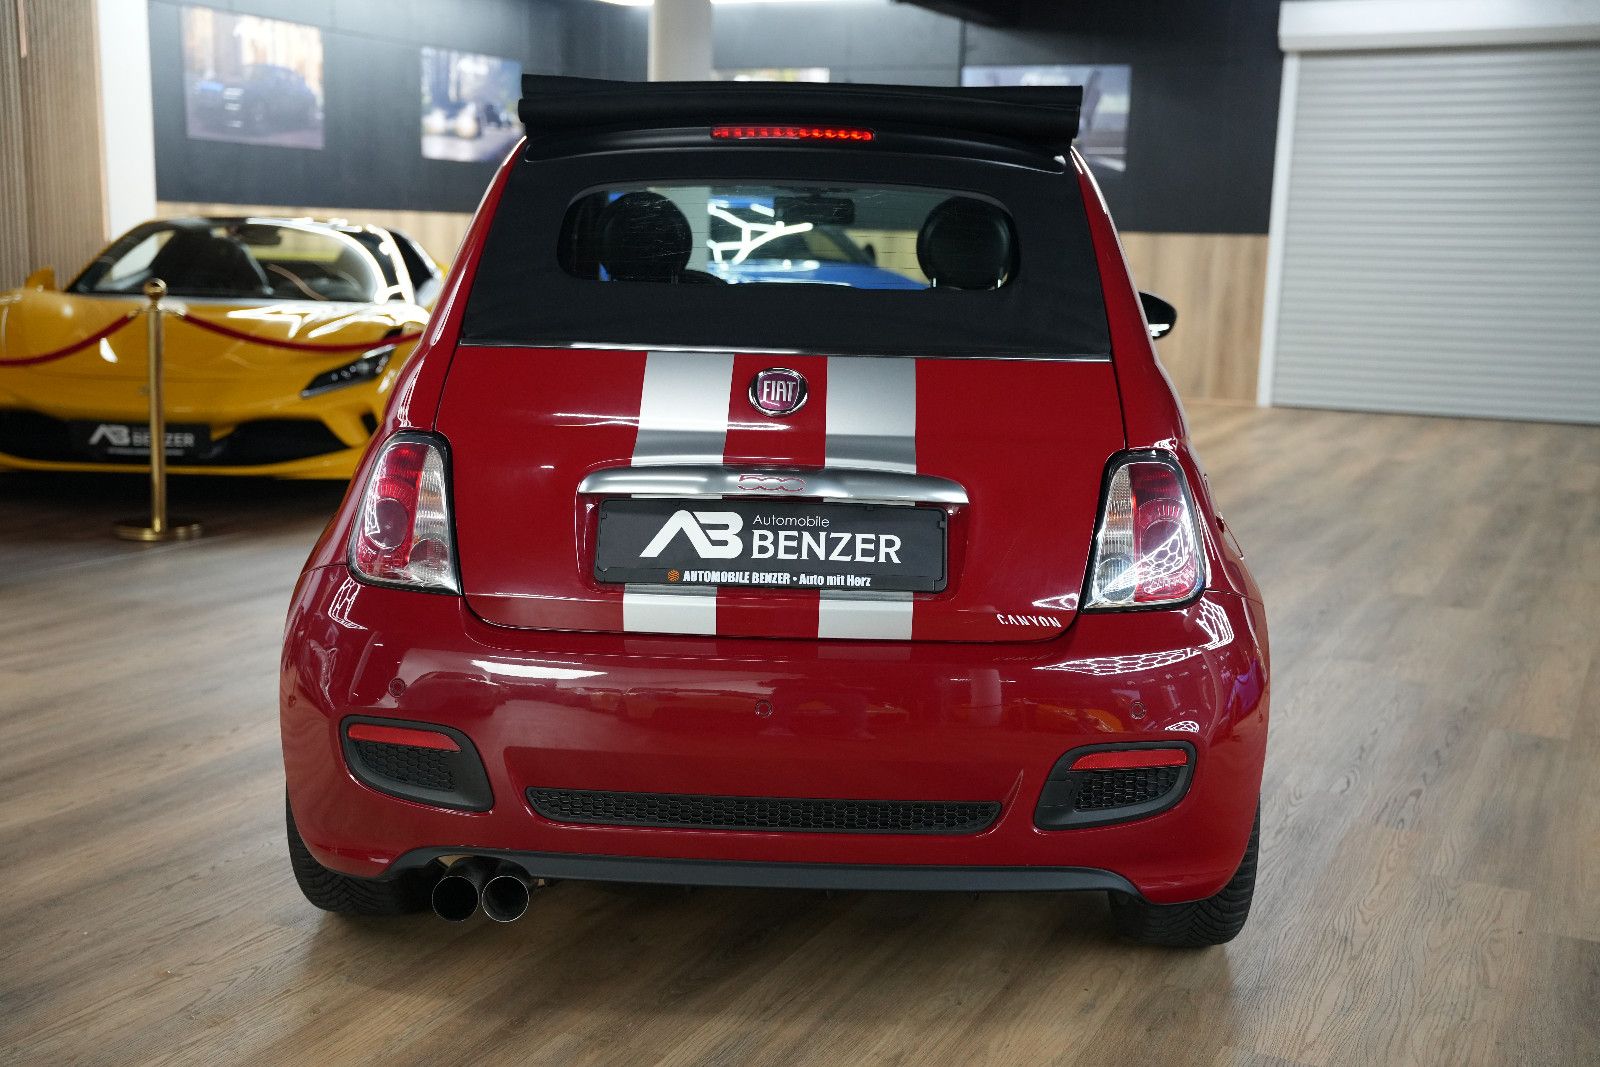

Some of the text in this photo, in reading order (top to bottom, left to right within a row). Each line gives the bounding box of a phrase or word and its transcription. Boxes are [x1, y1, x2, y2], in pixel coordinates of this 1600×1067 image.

[762, 380, 797, 402] FIAT
[132, 431, 195, 447] BEZER
[737, 472, 806, 493] 500
[752, 514, 830, 528] Automobile
[639, 509, 744, 559] AB
[750, 529, 902, 564] BENZER
[682, 570, 872, 587] AUTOMOBILE BENZER Auto mit Herz
[996, 613, 1062, 628] CANYON
